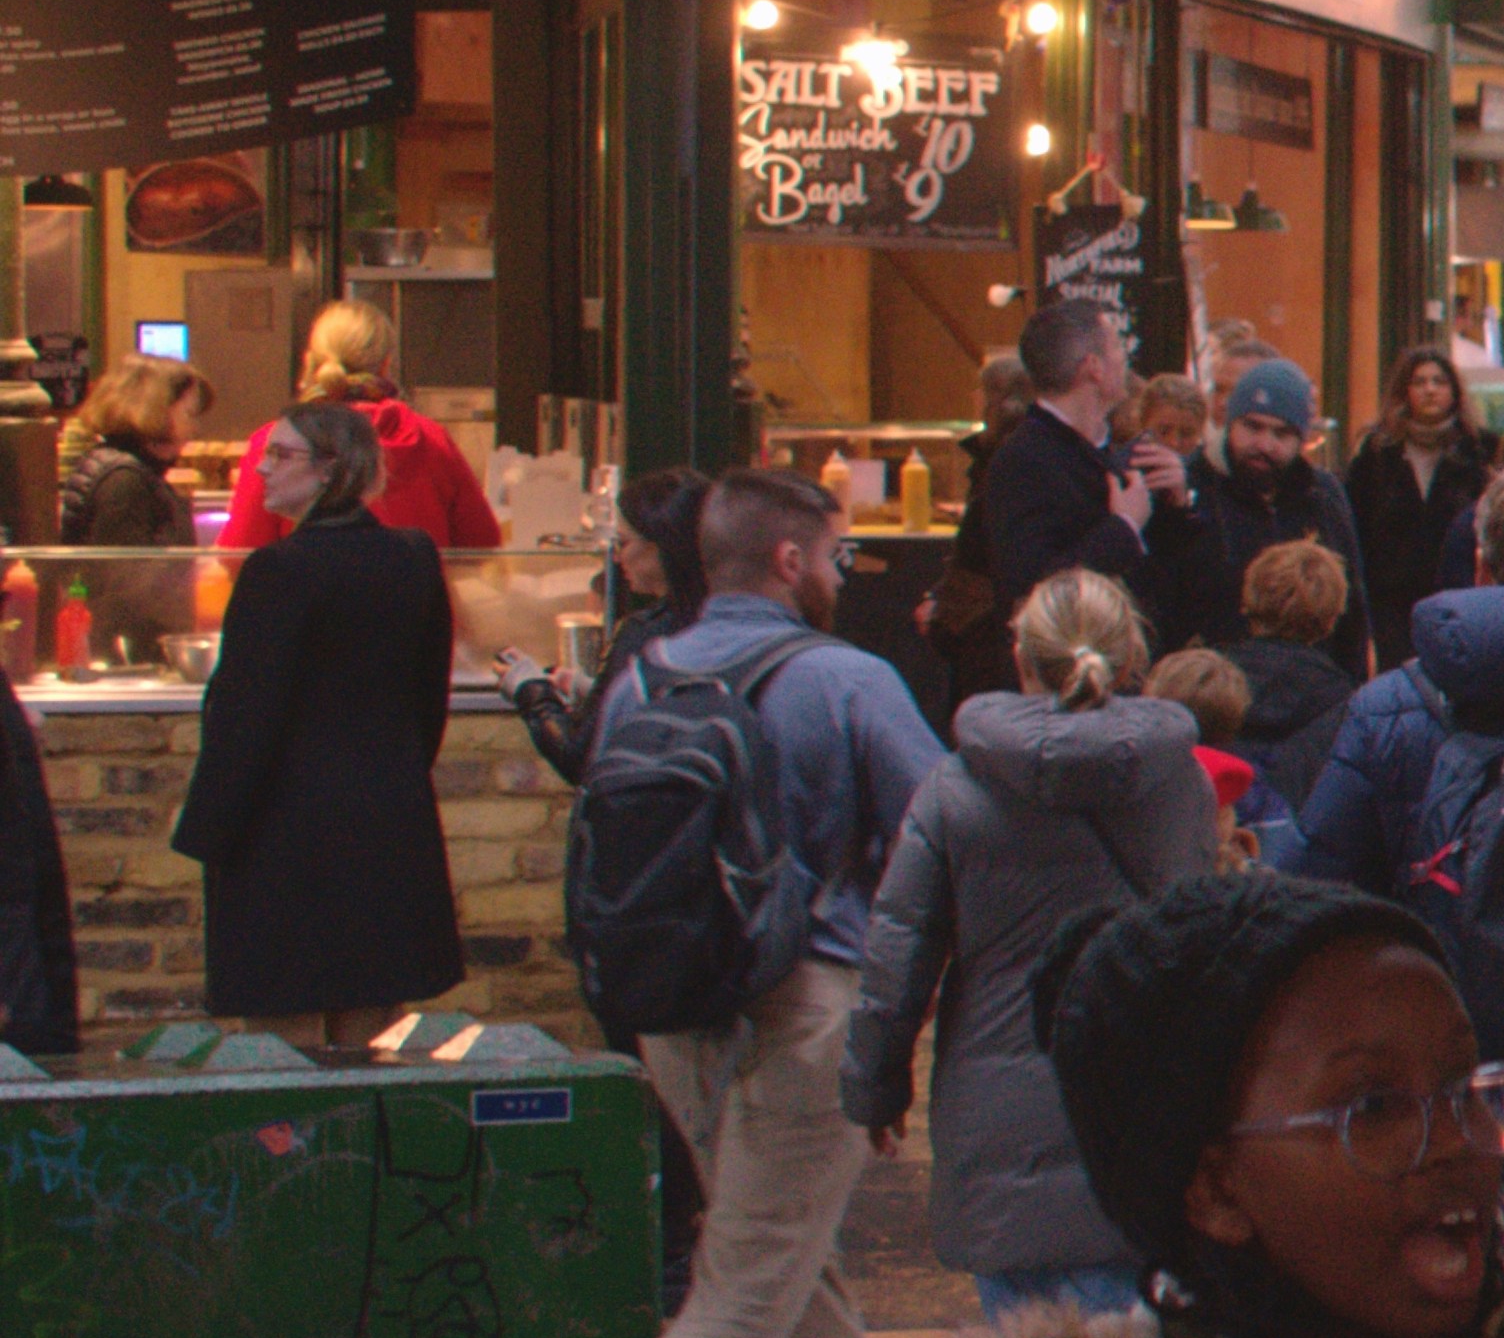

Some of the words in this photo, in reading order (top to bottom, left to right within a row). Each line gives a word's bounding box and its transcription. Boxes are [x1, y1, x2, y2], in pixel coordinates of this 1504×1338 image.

[738, 59, 853, 110] SALT
[737, 101, 900, 170] Sandwich
[754, 152, 870, 227] Bagel
